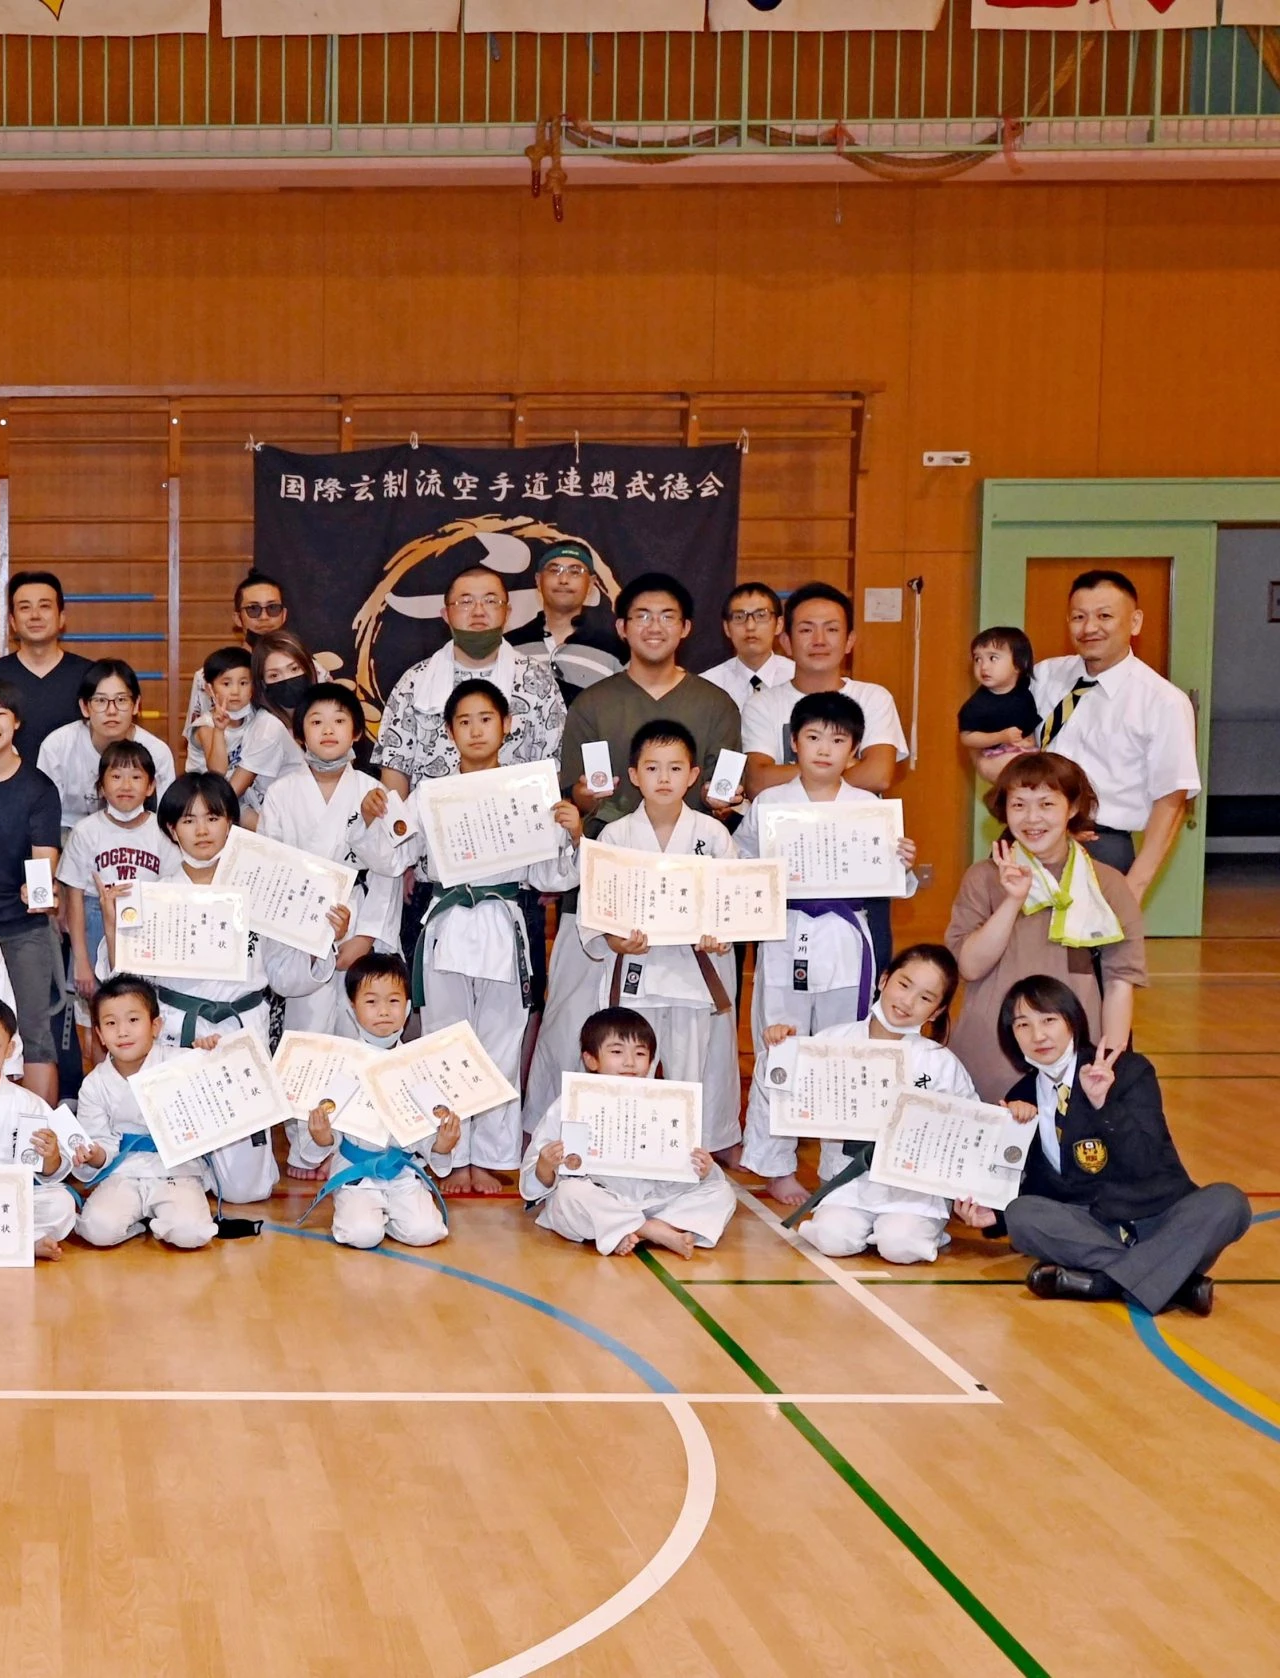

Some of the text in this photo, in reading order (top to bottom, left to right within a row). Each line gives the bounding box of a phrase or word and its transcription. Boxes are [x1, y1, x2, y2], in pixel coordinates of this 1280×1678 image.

[279, 467, 726, 503] 国際玄制流空手道連盟武徳会
[530, 804, 545, 831] 賞状
[94, 847, 161, 876] TOGETHER
[871, 836, 883, 866] 賞状
[116, 865, 137, 881] WE
[309, 894, 325, 923] 賞状
[677, 888, 689, 915] 賞状
[753, 889, 765, 916] 賞状
[217, 920, 228, 950] 賞状
[797, 933, 809, 955] 石川
[242, 1067, 263, 1098] 賞状
[459, 1058, 484, 1085] 賞状
[669, 1117, 680, 1149] 賞状
[0, 1203, 12, 1235] 賞状
